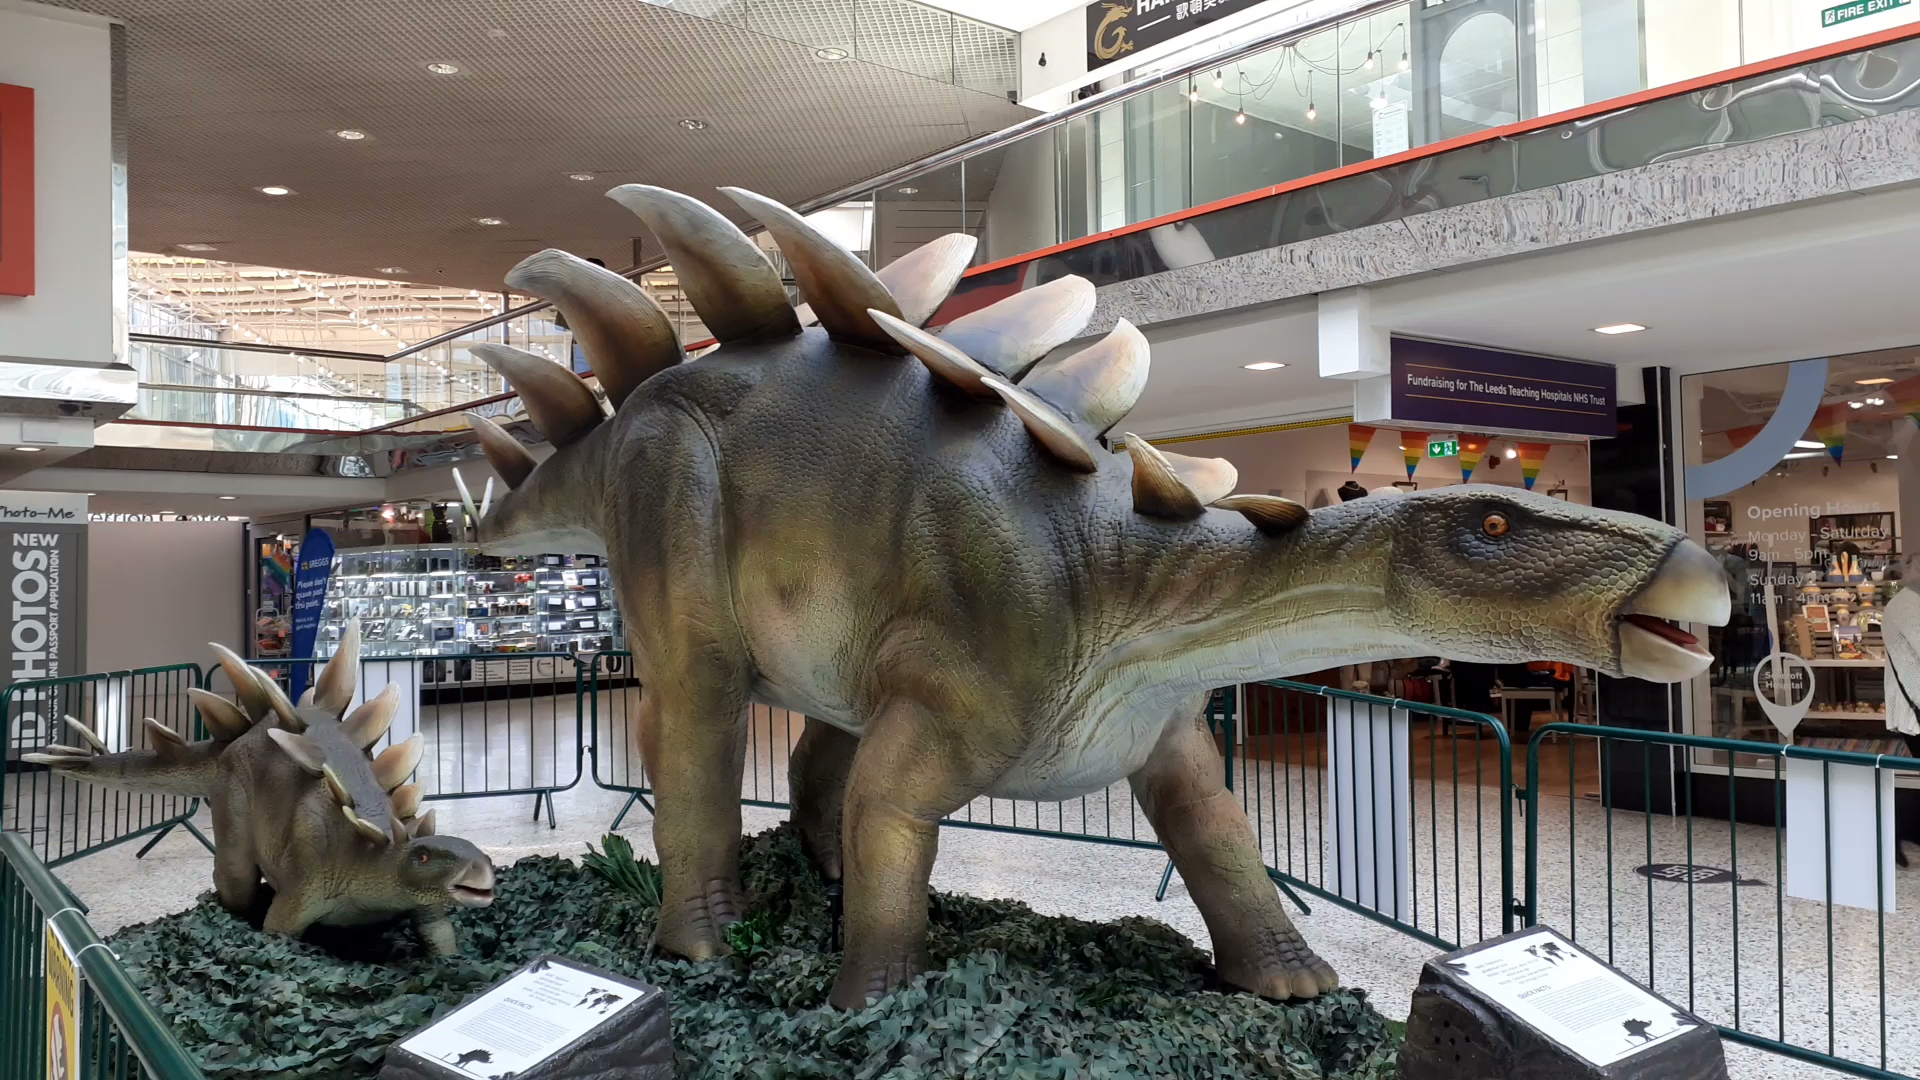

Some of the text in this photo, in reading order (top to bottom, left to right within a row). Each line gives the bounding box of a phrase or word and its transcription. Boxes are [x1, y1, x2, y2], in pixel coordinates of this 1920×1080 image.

[1136, 0, 1174, 16] HA
[1838, 4, 1864, 20] FIRE
[1407, 373, 1606, 406] Fundraising for The Leeds Teaching Hospitals NHS Trust
[1747, 501, 1881, 521] Opening Hours
[13, 533, 59, 547] NEW
[1748, 529, 1807, 543] Monday
[1820, 525, 1889, 540] Saturday
[309, 557, 328, 568] GREGGS
[1748, 549, 1780, 562] 9am
[1794, 548, 1828, 565] 5pm
[49, 549, 60, 610] APPLICATION
[1750, 573, 1804, 588] Sunday
[1750, 592, 1784, 605] 11am
[48, 611, 59, 660] PASSPORT
[11, 550, 48, 749] ID PHOTOS
[48, 661, 59, 697] OINE
